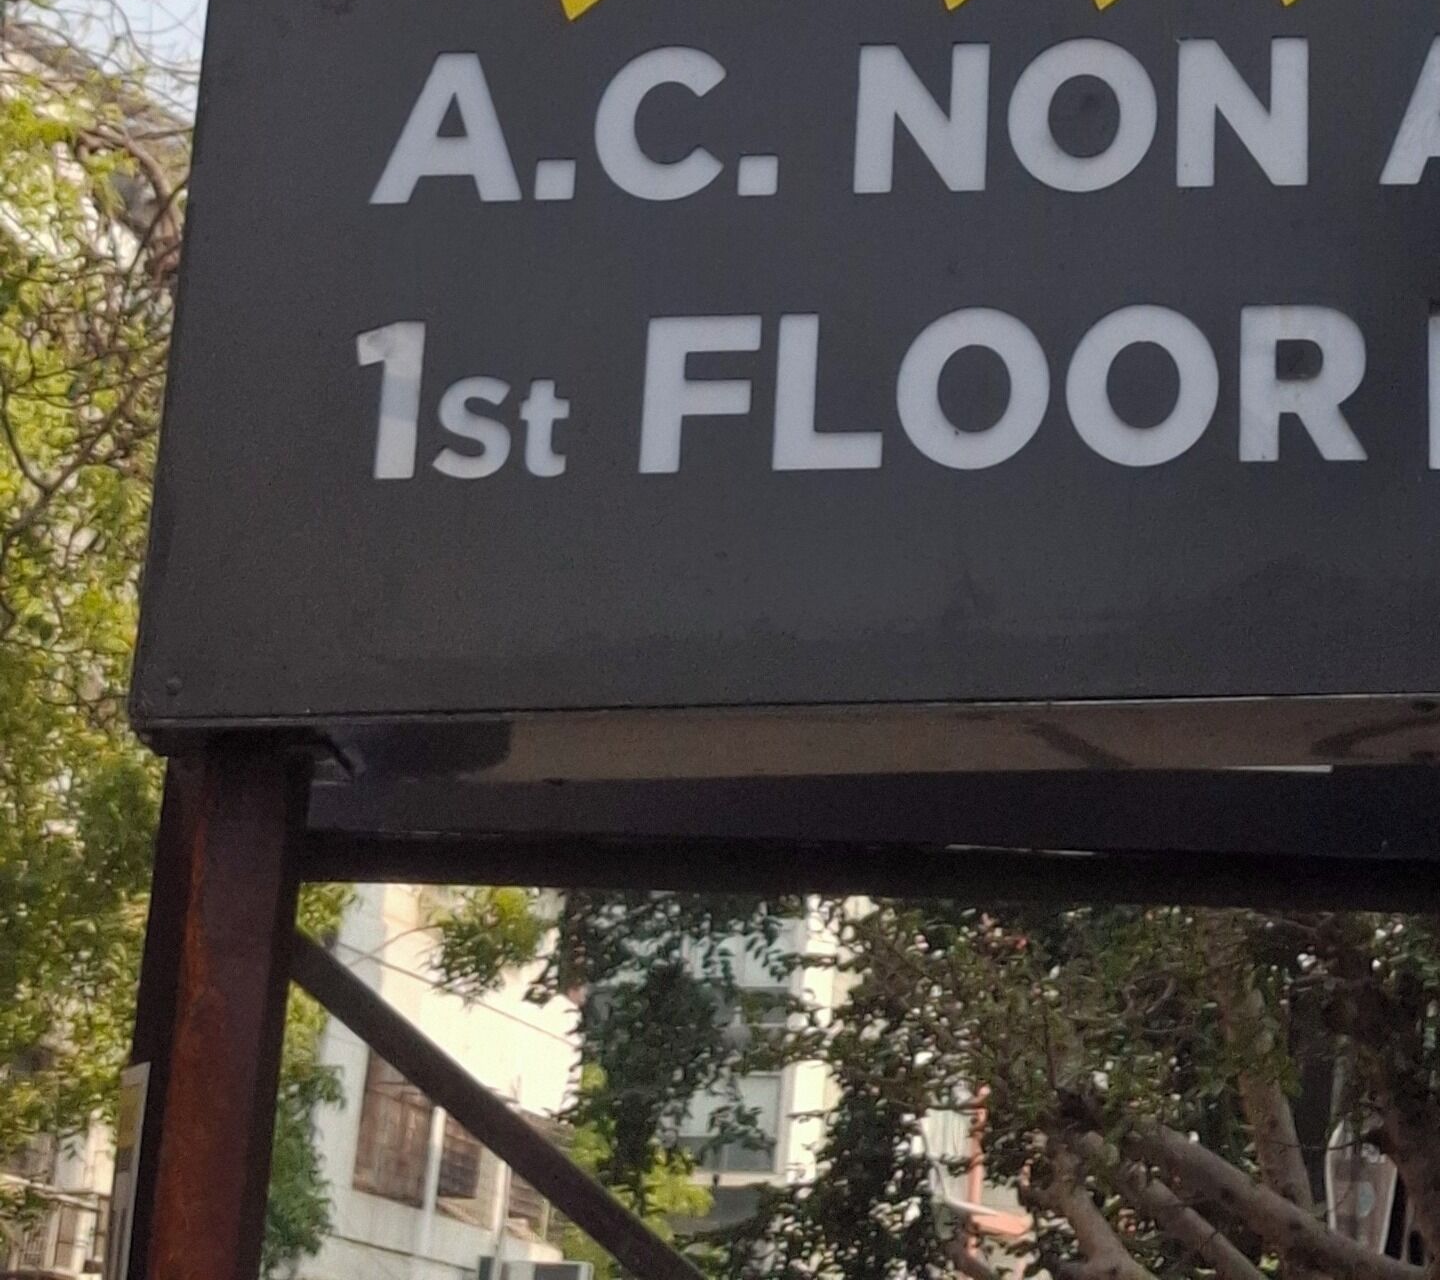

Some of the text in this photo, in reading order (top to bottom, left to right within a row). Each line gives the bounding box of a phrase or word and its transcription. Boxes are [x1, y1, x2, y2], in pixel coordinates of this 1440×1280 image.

[369, 45, 778, 204] A.C.
[853, 38, 1309, 193] NON
[356, 321, 570, 479] 1st
[637, 305, 1368, 474] FLOOR
